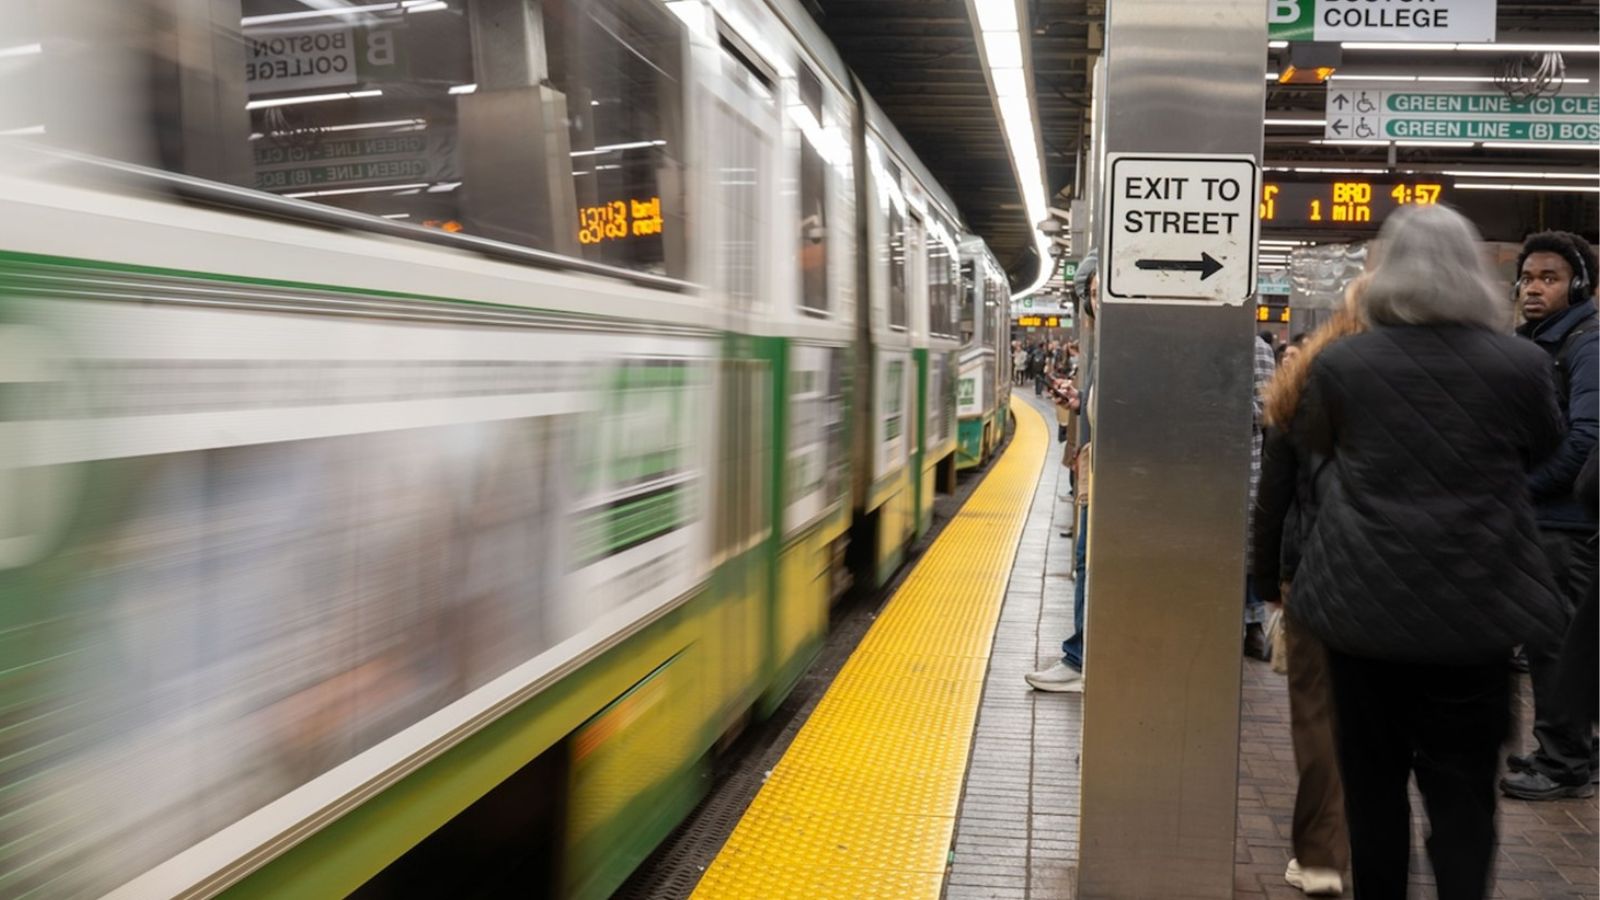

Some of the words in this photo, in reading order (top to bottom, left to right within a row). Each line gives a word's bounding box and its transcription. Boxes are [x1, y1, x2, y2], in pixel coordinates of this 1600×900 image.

[1324, 8, 1449, 28] COLLEGE
[1395, 95, 1461, 111] GREEN
[1468, 97, 1511, 112] LINE
[1530, 98, 1555, 115] (C)
[1561, 98, 1599, 113] CLE
[1394, 121, 1460, 137] GREEN
[1467, 122, 1510, 138] LINE
[1528, 123, 1553, 141] (B)
[1560, 124, 1599, 139] BOS
[1125, 177, 1189, 200] EXIT
[1201, 178, 1240, 202] TO
[1333, 183, 1371, 203] BRD
[1391, 184, 1442, 205] 4:57
[1310, 200, 1321, 221] 1
[1332, 202, 1371, 222] min
[1124, 210, 1240, 235] STREET
